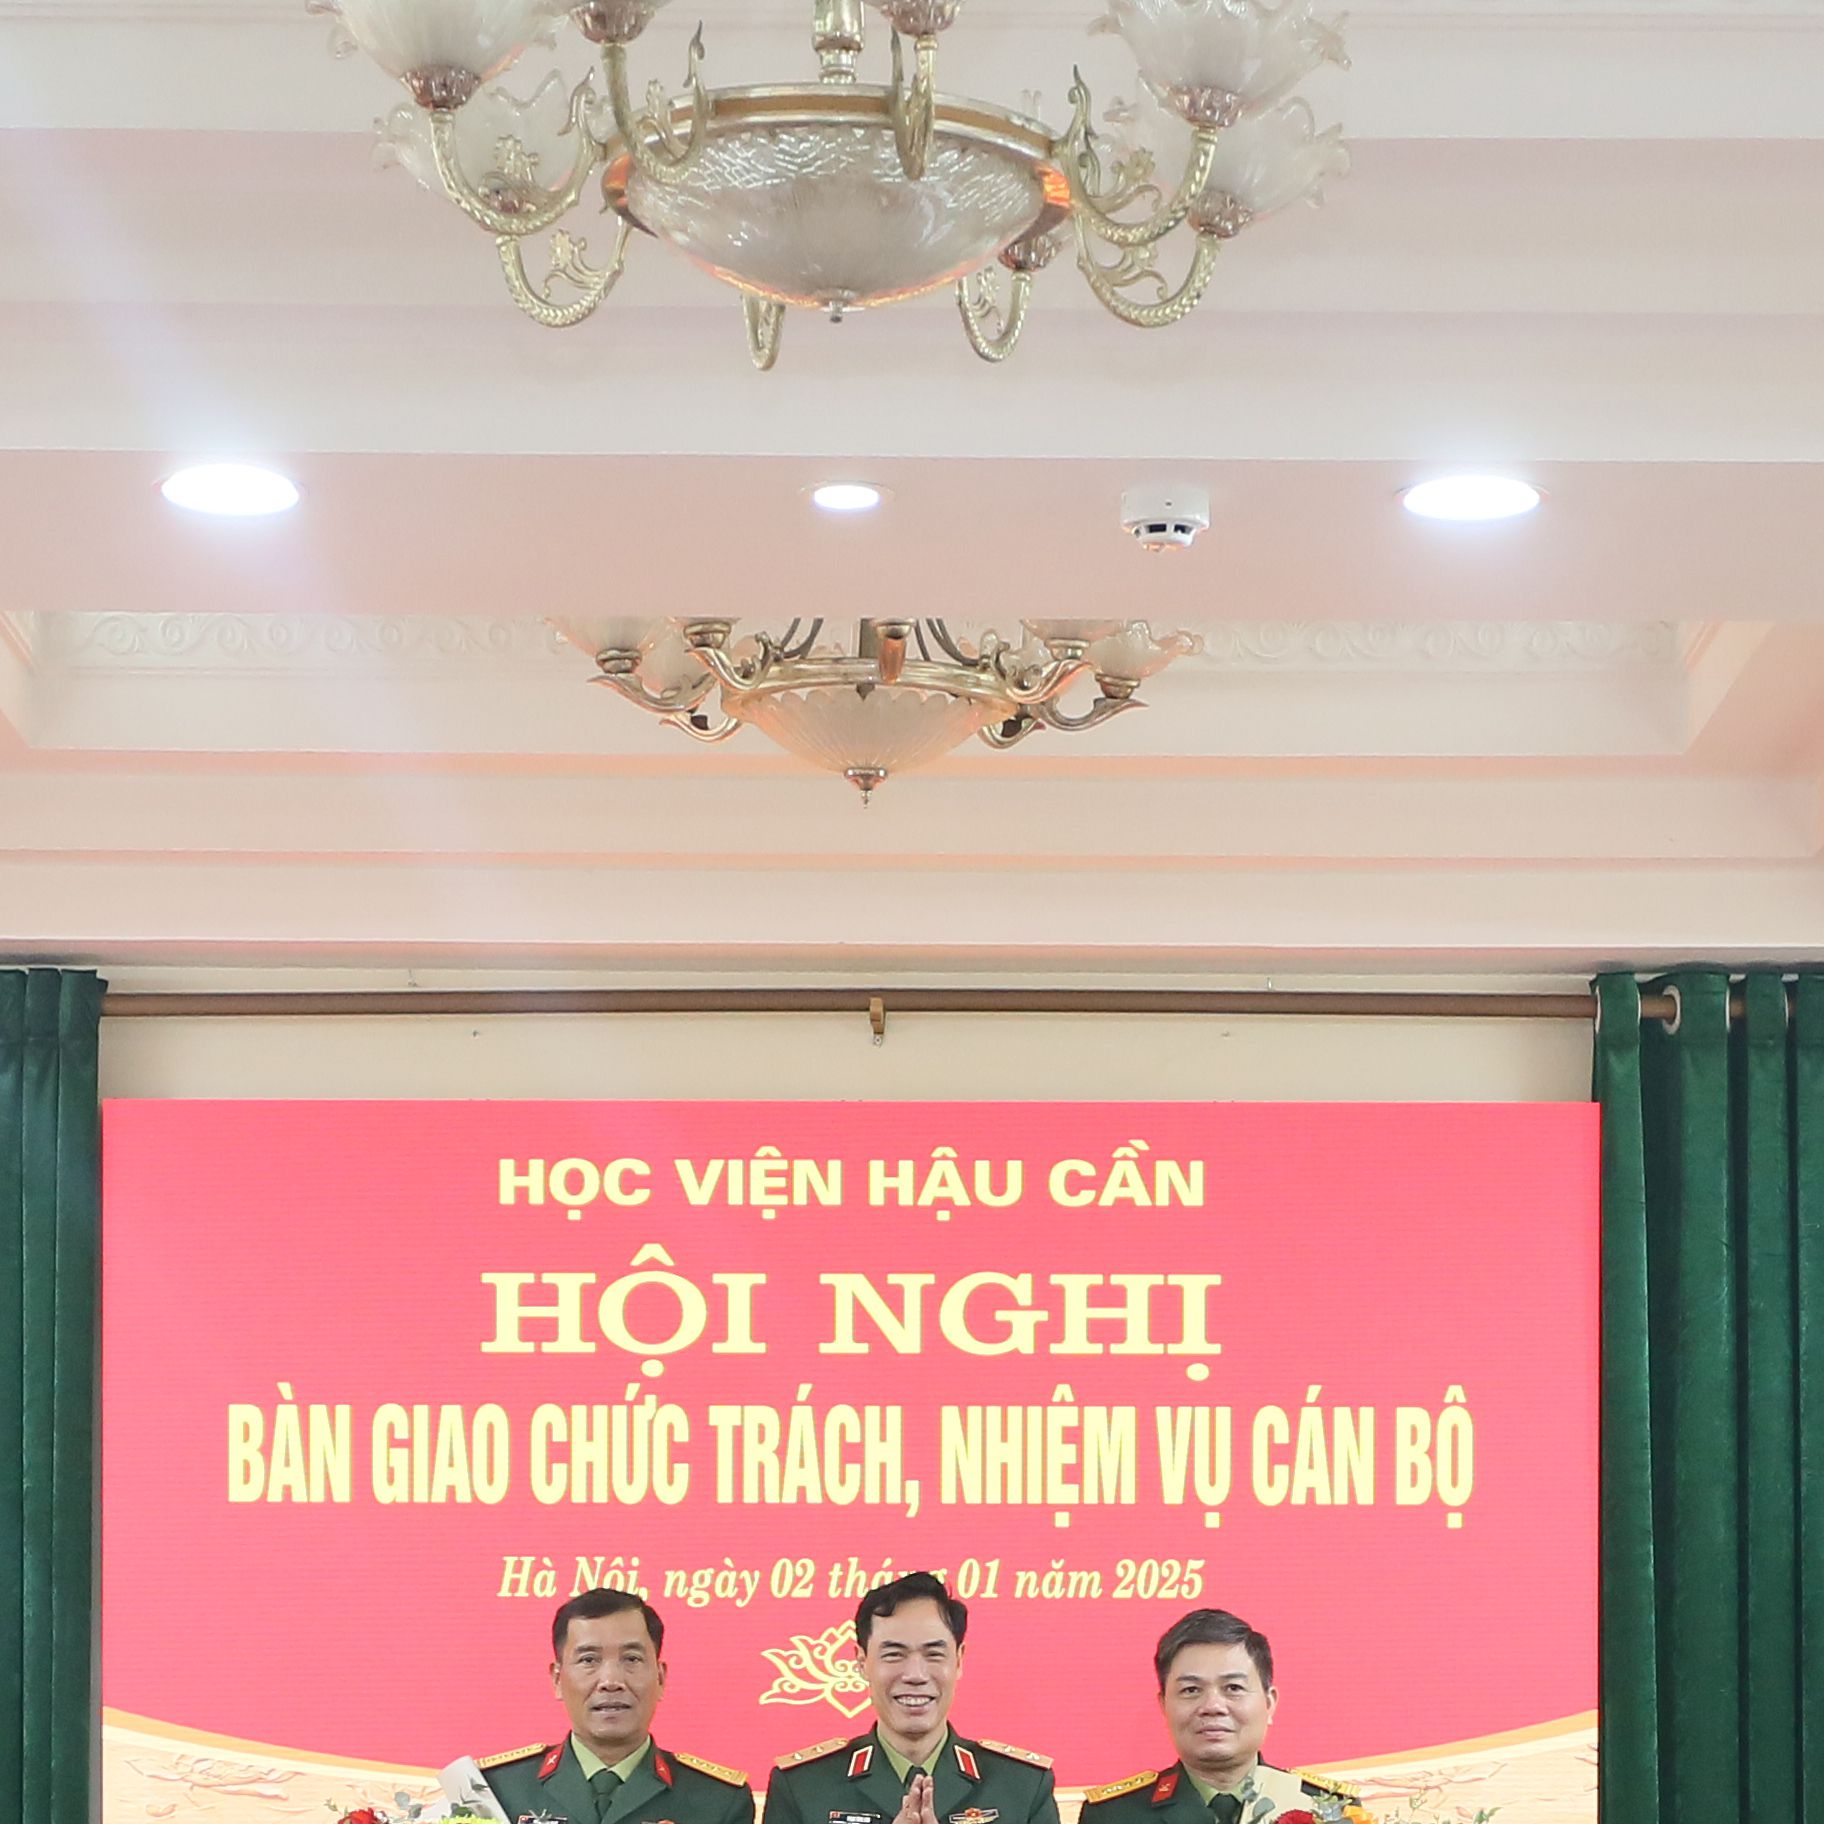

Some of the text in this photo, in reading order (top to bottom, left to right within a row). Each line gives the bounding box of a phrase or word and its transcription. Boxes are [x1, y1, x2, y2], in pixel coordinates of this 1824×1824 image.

[497, 1138, 1206, 1222] HỌC VIỆN HẬU CẦN
[479, 1242, 1224, 1382] HỘI NGHỊ
[226, 1381, 1475, 1530] BÀN GIAO CHỨC TRÁCH, NHIỆM VỤ CÁN BỘ
[496, 1555, 558, 1598] Hà
[662, 1556, 762, 1609] ngày
[769, 1557, 817, 1600] 02
[827, 1556, 949, 1599] thá
[956, 1557, 1001, 1600] 01
[1013, 1558, 1104, 1600] năm
[1111, 1558, 1206, 1601] 2025
